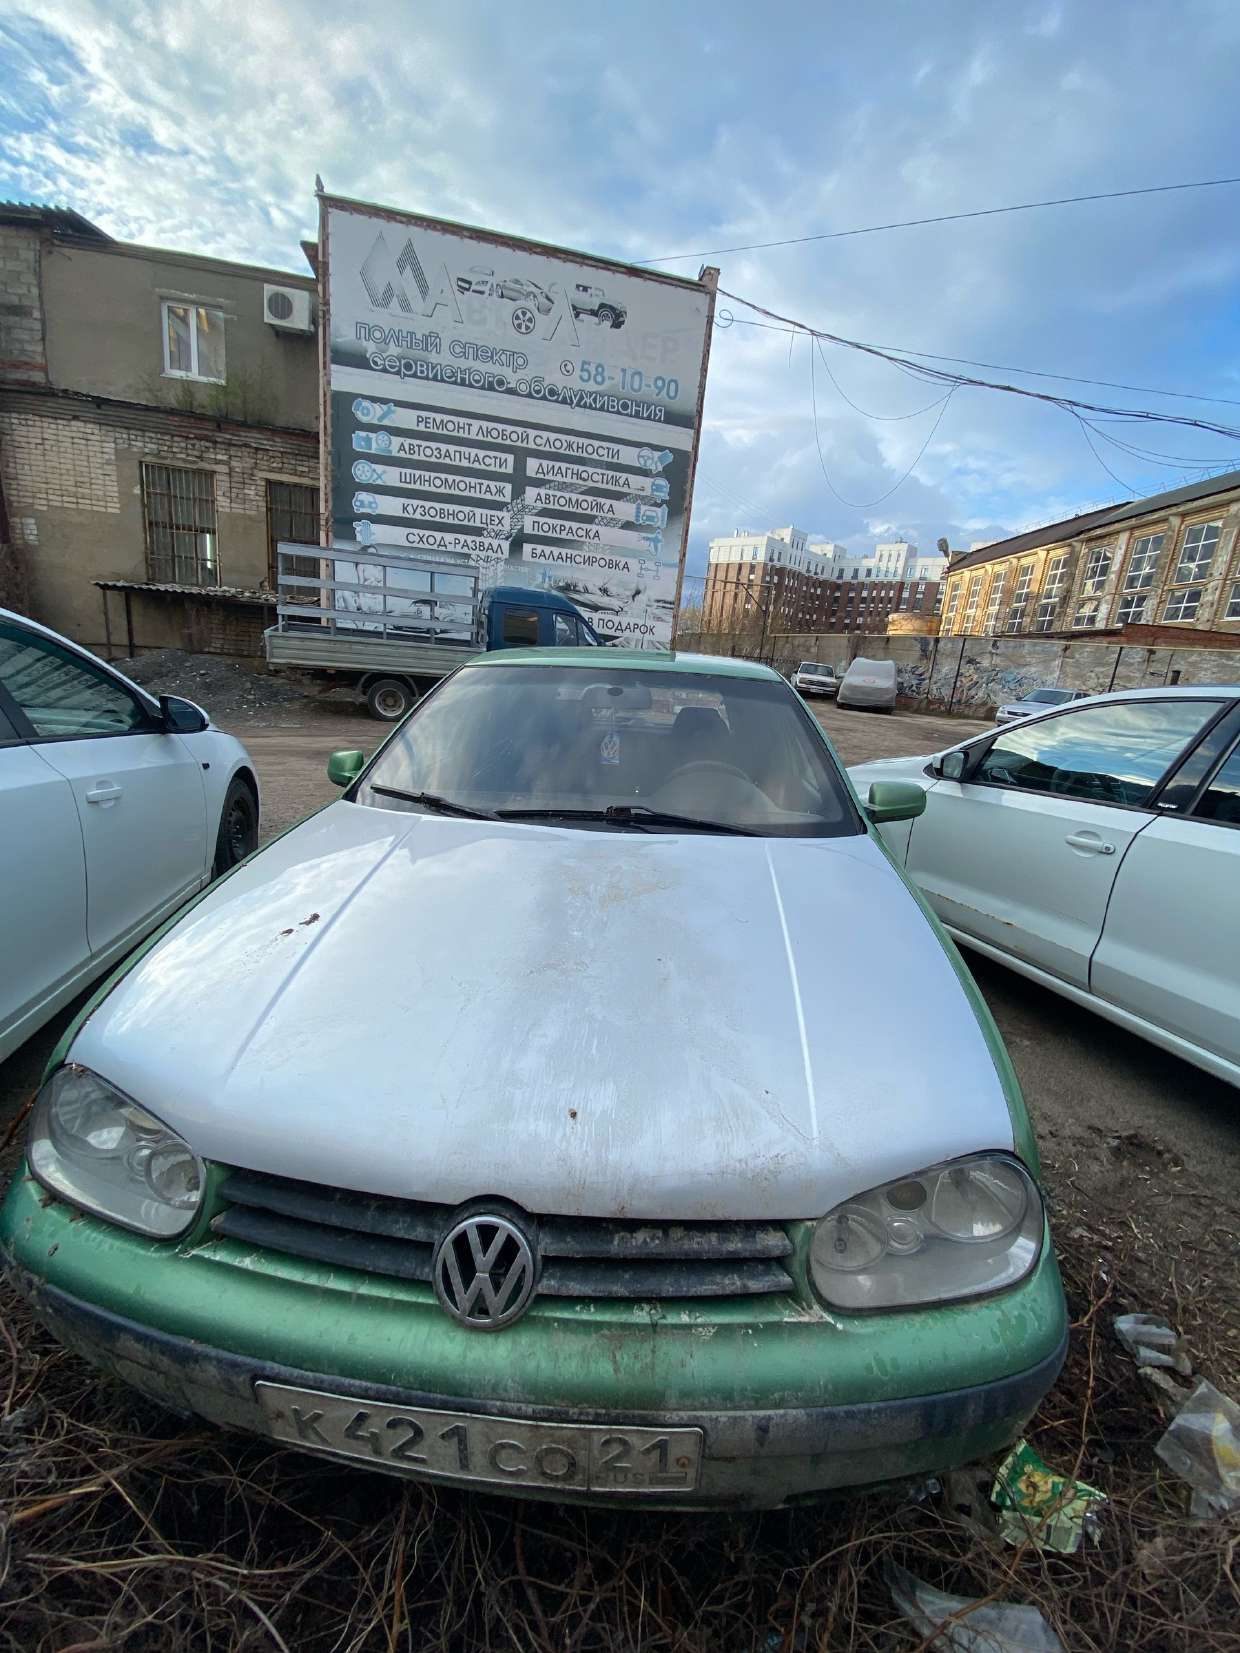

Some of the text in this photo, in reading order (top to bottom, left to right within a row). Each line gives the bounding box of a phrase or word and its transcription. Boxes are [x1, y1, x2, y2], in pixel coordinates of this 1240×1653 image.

[369, 351, 665, 422] сервисного обслуживания
[578, 360, 680, 401] 58-10-90
[416, 415, 620, 461] РЕМОНТ ЛЮБОЙ СЛОЖНОСТИ
[397, 441, 508, 470] АВТОЗАПЧАСТИ
[399, 471, 506, 498] ШИНОМОНТАЖ
[535, 463, 631, 489] ДИАГНОСТИКА
[402, 503, 505, 527] КУЗОВНОЙ ЦЕХ
[534, 493, 615, 515] АВТОМОЙКА
[406, 532, 504, 555] СХОД-РАЗВАЛ
[532, 520, 600, 541] ПОКРАСКА
[531, 548, 630, 573] БАЛАНСИРОВКА
[597, 617, 656, 636] ПОДАРОК
[599, 1434, 670, 1474] 21
